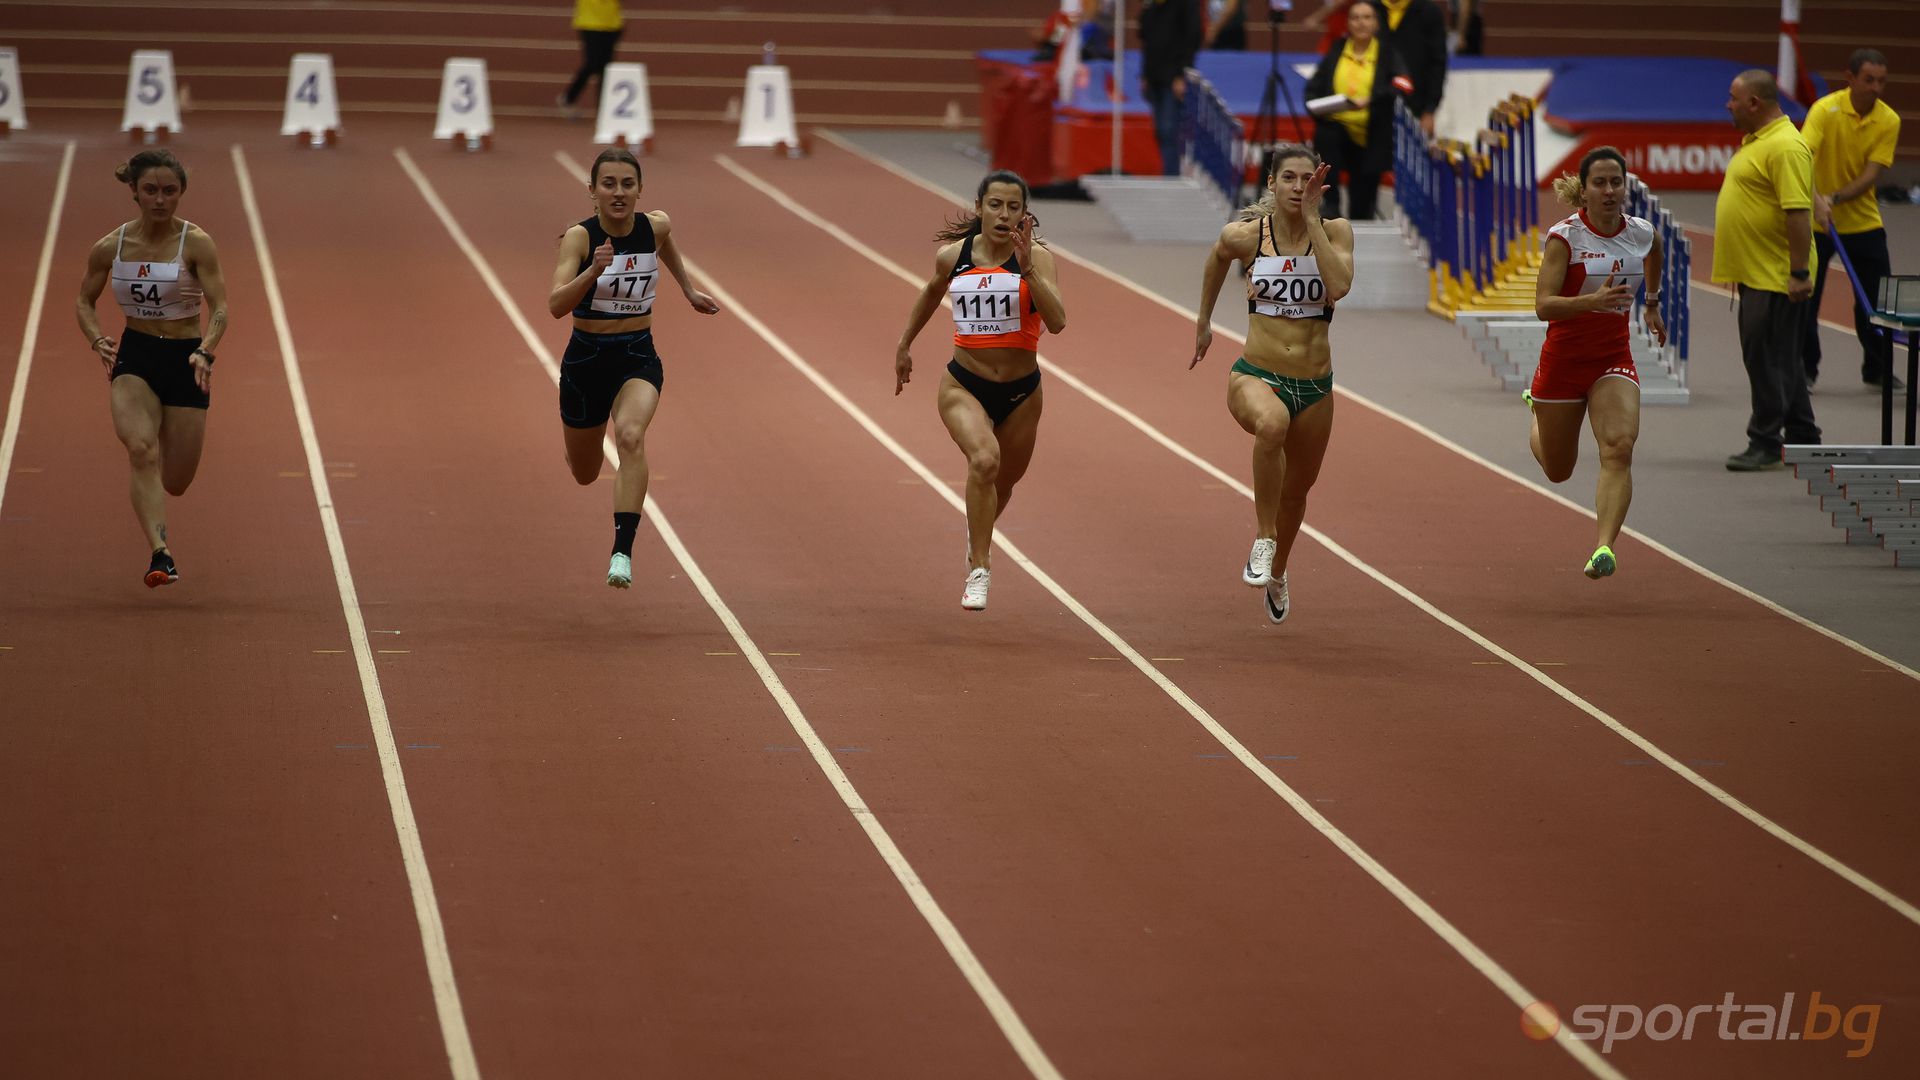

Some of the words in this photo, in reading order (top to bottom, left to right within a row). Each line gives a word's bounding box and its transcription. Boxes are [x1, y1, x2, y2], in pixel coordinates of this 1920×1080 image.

[137, 66, 164, 105] 5
[295, 71, 319, 106] 4
[451, 75, 476, 113] 3
[612, 81, 636, 118] 2
[760, 84, 774, 119] 1
[1647, 143, 1733, 174] MON
[137, 263, 151, 278] A1
[624, 255, 638, 271] A1
[1281, 257, 1297, 273] A1
[1611, 258, 1624, 273] A1
[609, 275, 652, 298] 177
[977, 274, 992, 289] A1
[1254, 278, 1324, 303] 2200
[130, 283, 162, 306] 54
[620, 304, 643, 312] БФЛА
[956, 294, 1011, 319] 1111
[1281, 307, 1305, 316] БФЛА
[977, 324, 1001, 332] БФЛА
